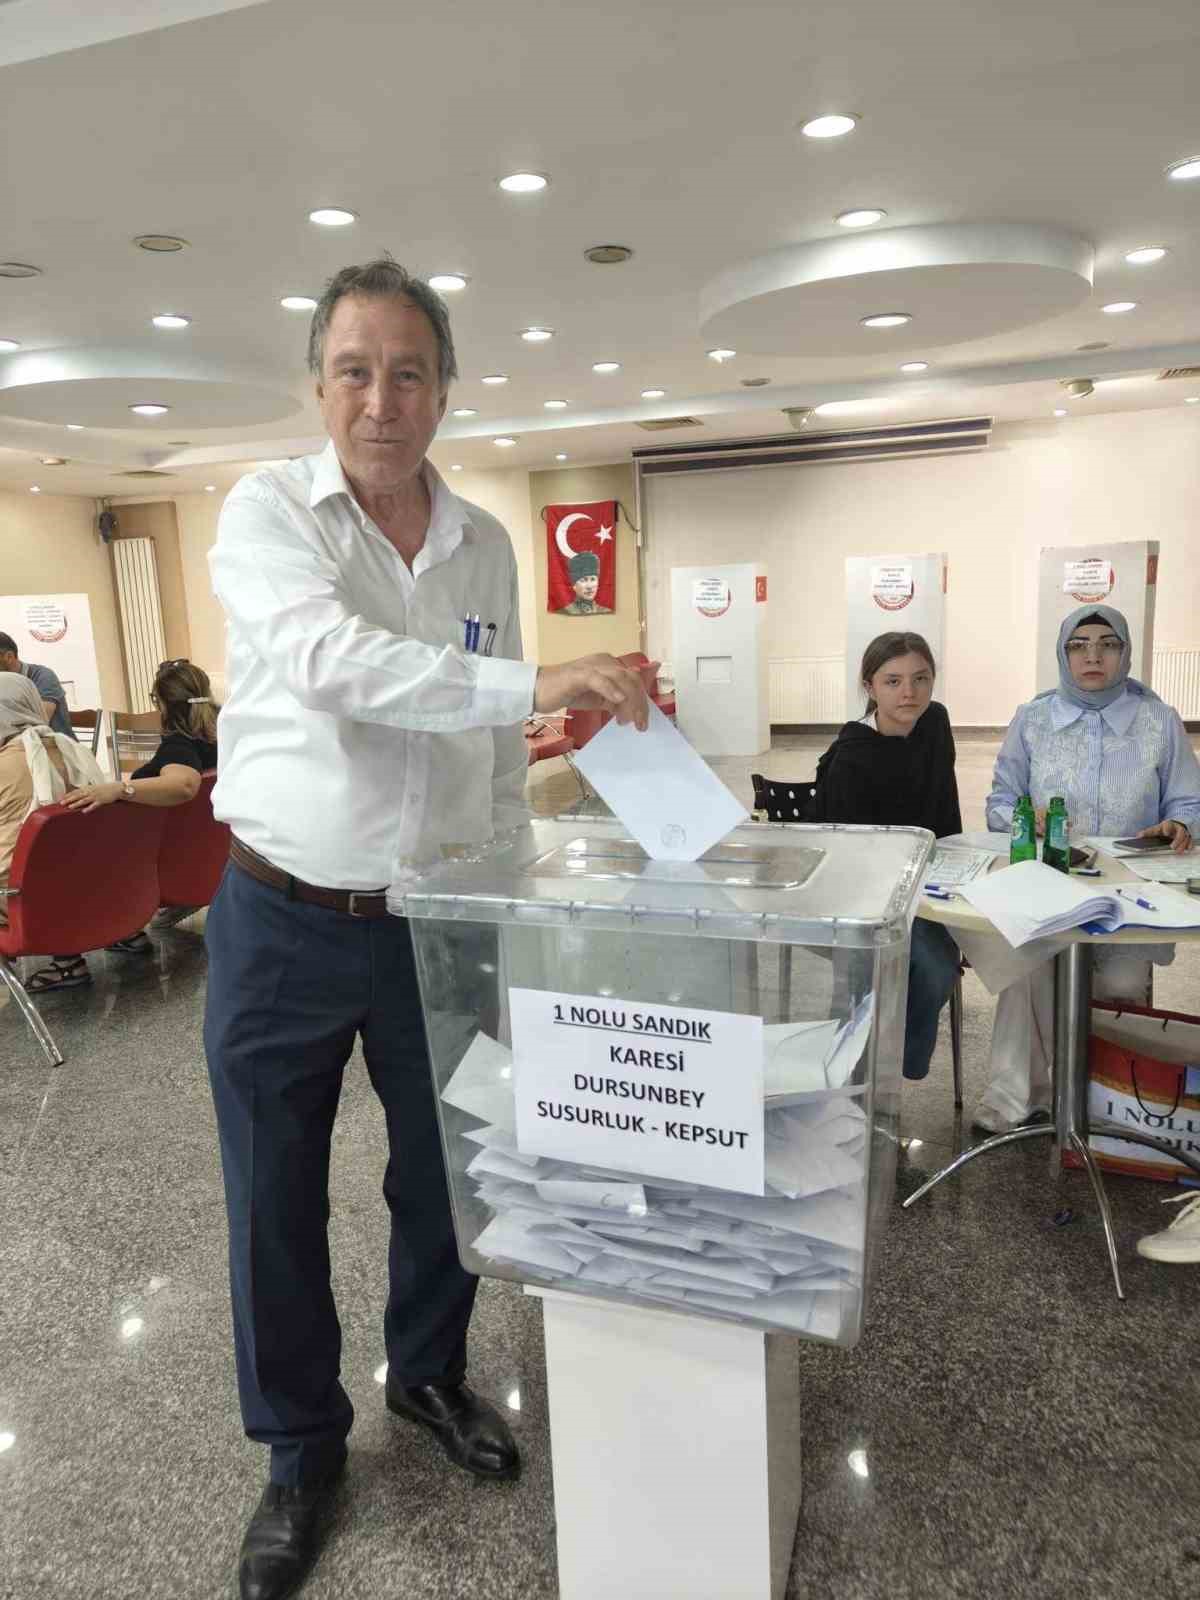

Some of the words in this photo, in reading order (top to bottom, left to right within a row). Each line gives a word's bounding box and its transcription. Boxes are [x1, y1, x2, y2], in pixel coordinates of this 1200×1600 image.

[554, 1004, 565, 1021] 1
[570, 1006, 627, 1028] NOLU
[632, 1013, 711, 1040] SANDIK
[610, 1045, 685, 1072] KARESİ
[574, 1073, 705, 1109] DURSUNBEY
[537, 1100, 646, 1134] SUSURLUK
[665, 1121, 749, 1150] KEPSUT
